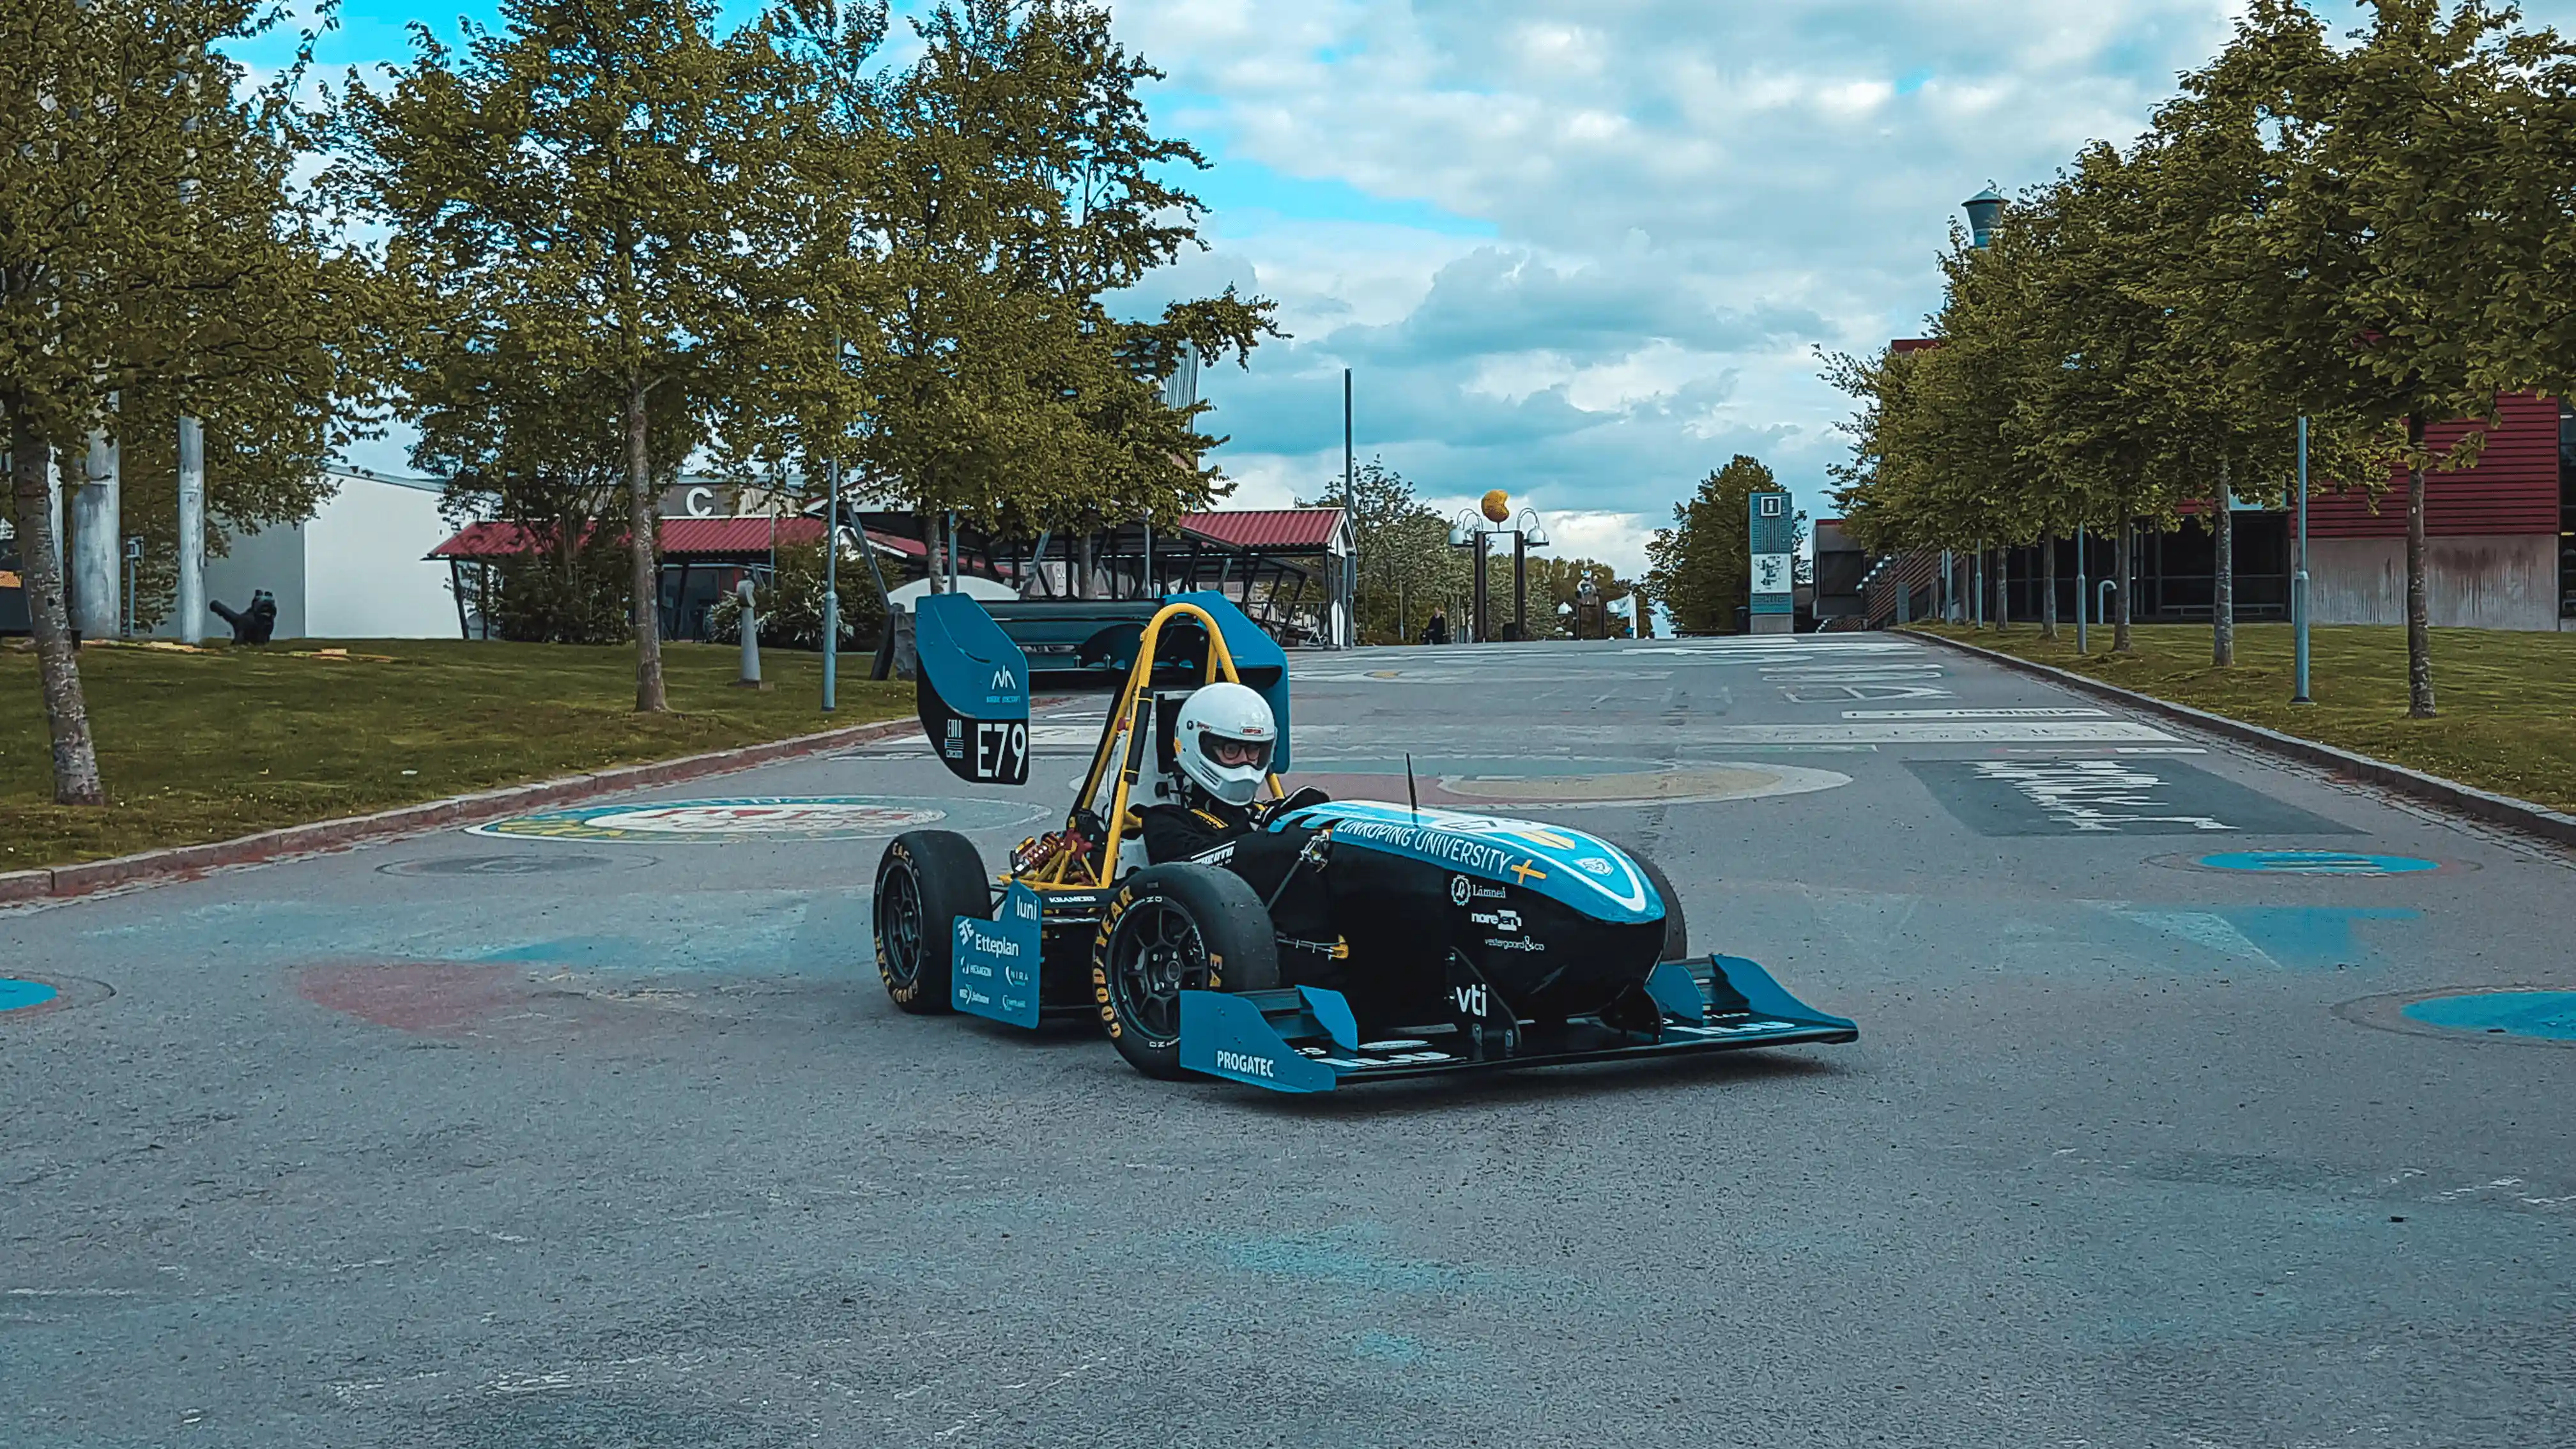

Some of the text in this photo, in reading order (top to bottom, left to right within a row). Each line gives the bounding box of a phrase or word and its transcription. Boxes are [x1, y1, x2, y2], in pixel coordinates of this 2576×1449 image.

[686, 487, 714, 516] C
[977, 723, 1026, 779] E79
[1415, 833, 1514, 875] UNIVERSITY
[976, 933, 1019, 958] Etteplan
[1456, 984, 1487, 1017] vti
[1217, 1050, 1275, 1078] PROGATEC
